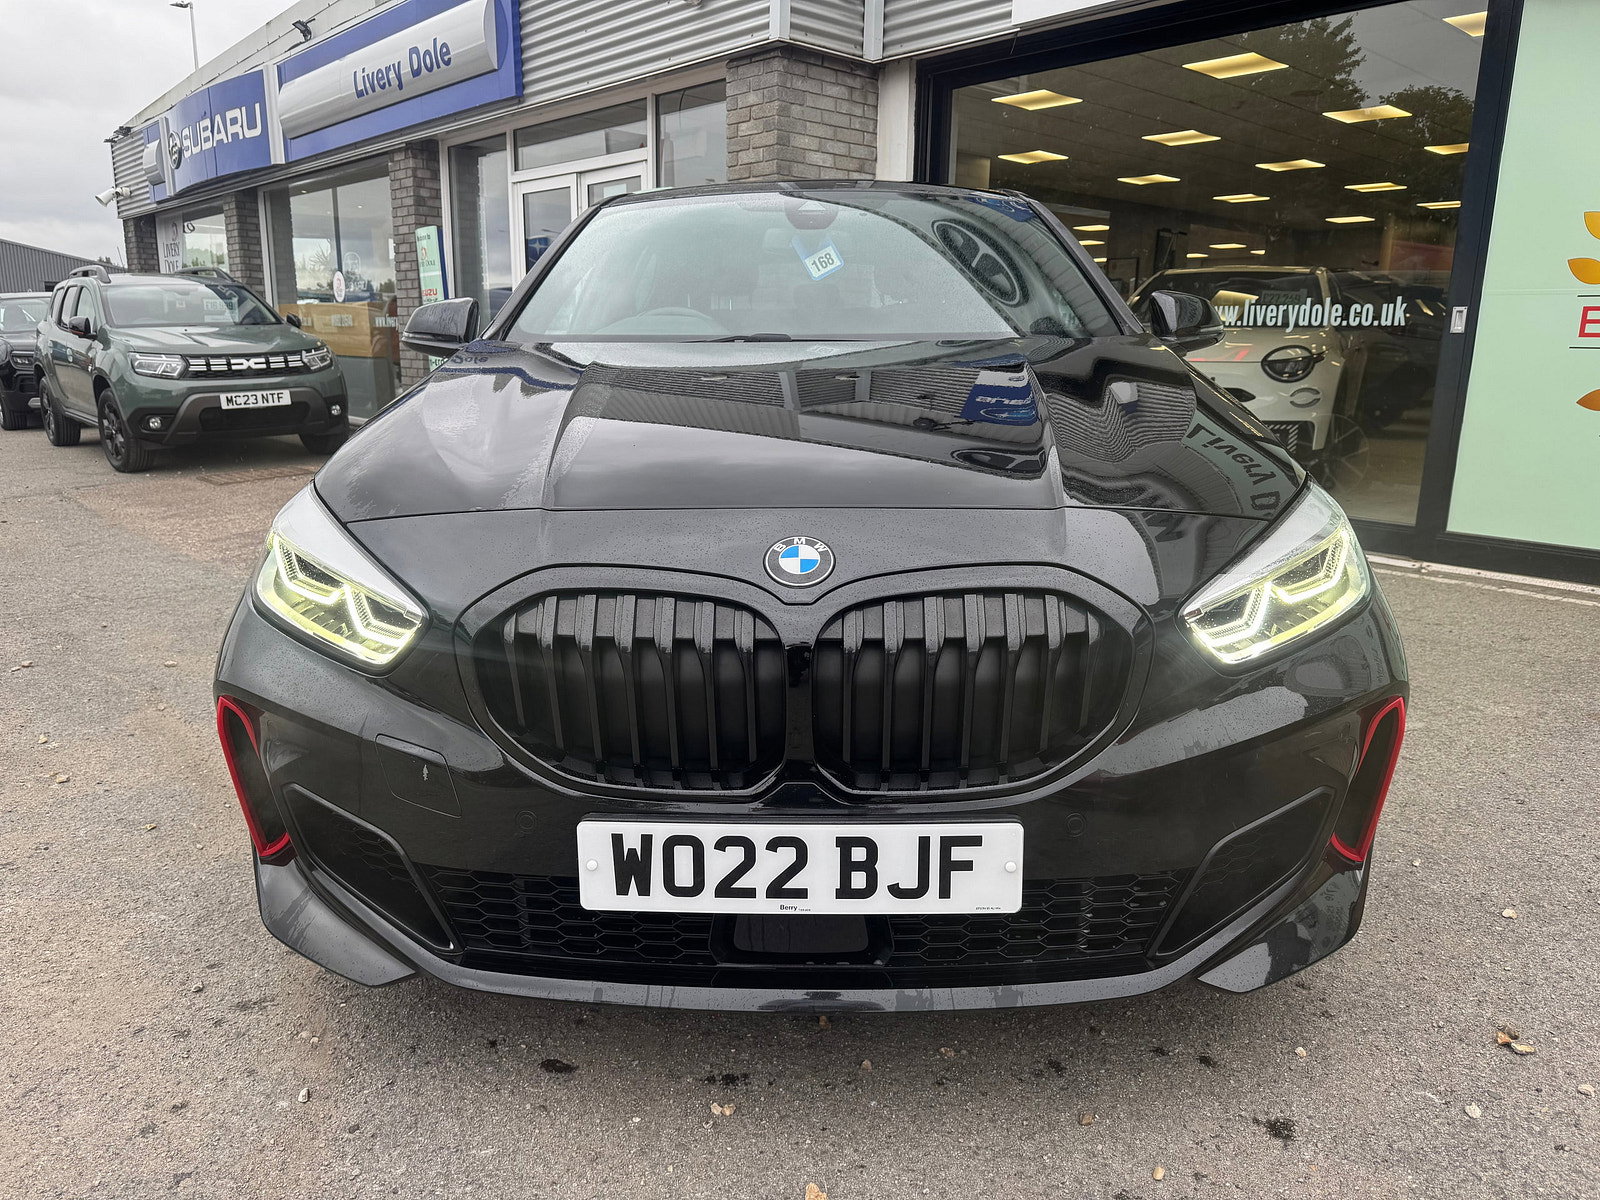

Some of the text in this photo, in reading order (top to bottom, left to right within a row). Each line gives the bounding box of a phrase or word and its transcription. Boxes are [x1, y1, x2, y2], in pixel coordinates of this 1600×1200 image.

[353, 37, 452, 99] Livery Dole
[181, 102, 262, 159] SUBARU
[811, 252, 835, 272] 168
[225, 392, 284, 407] MC23 NTF
[773, 537, 828, 552] BMW
[611, 833, 983, 900] WO22 BJF
